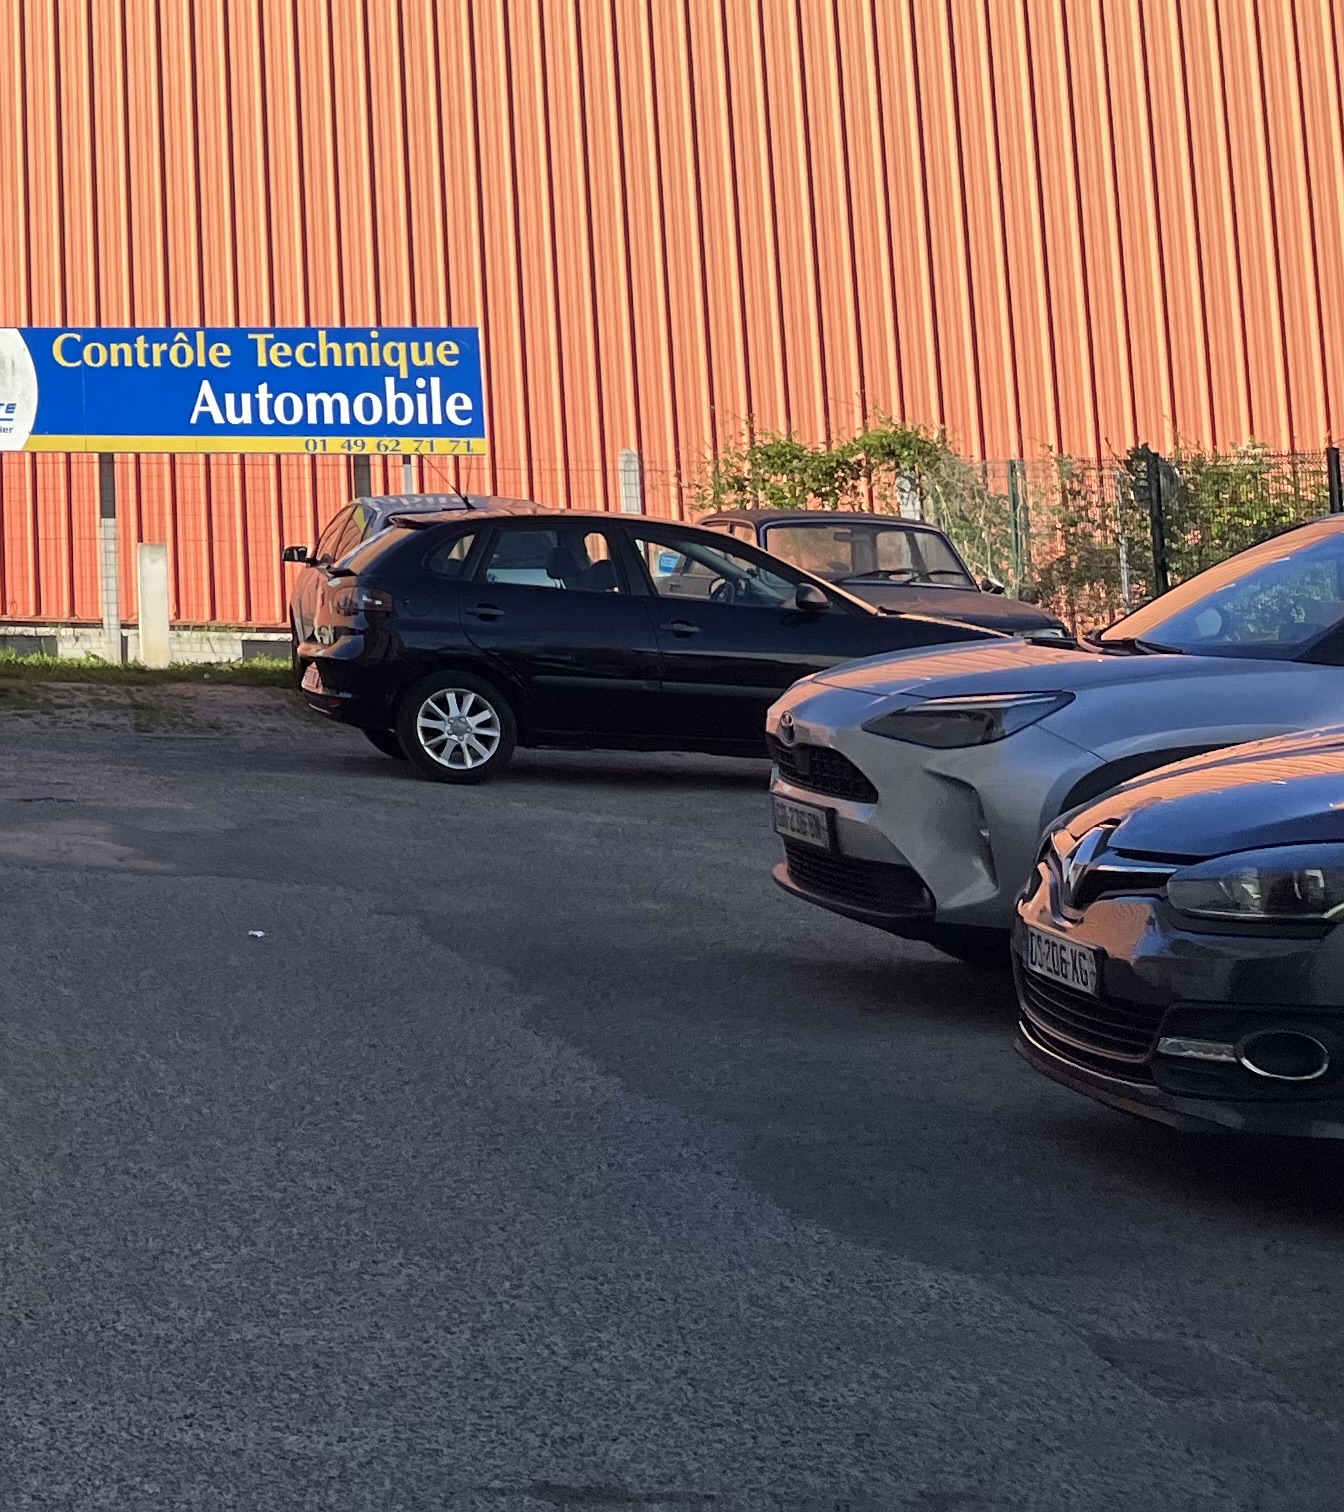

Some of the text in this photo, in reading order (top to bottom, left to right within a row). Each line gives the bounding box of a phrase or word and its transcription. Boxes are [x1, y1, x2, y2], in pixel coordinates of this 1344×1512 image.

[51, 330, 461, 379] Contrôle Technique
[189, 376, 473, 427] Automobile
[304, 438, 473, 454] 01 49 62 71 71
